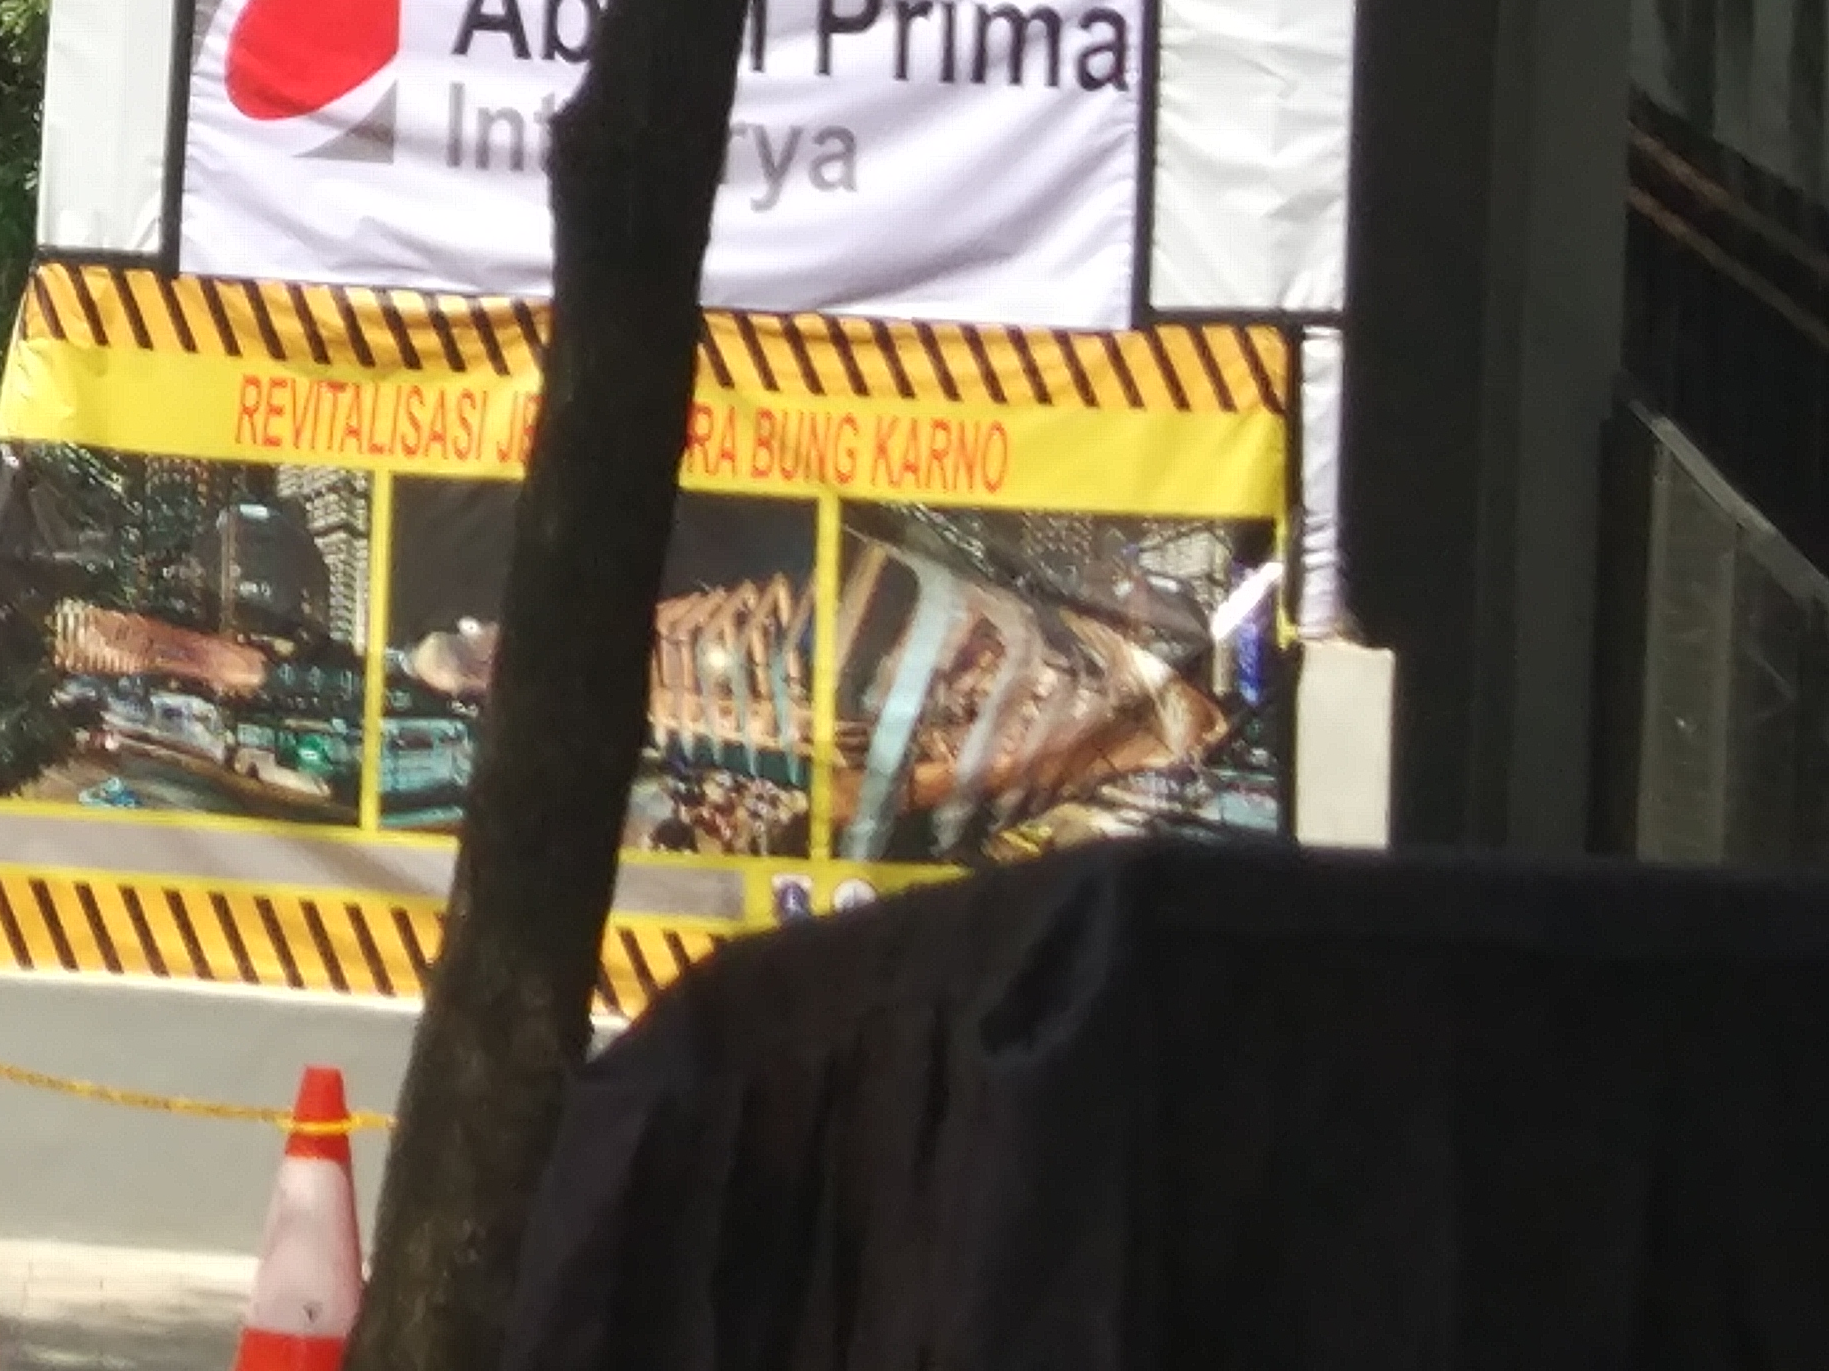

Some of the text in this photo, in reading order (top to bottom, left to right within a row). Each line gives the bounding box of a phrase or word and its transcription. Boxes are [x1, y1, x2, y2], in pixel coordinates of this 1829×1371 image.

[236, 373, 488, 461] REVITALISASI
[750, 406, 859, 484] BUNG
[869, 414, 1009, 493] KARNO
